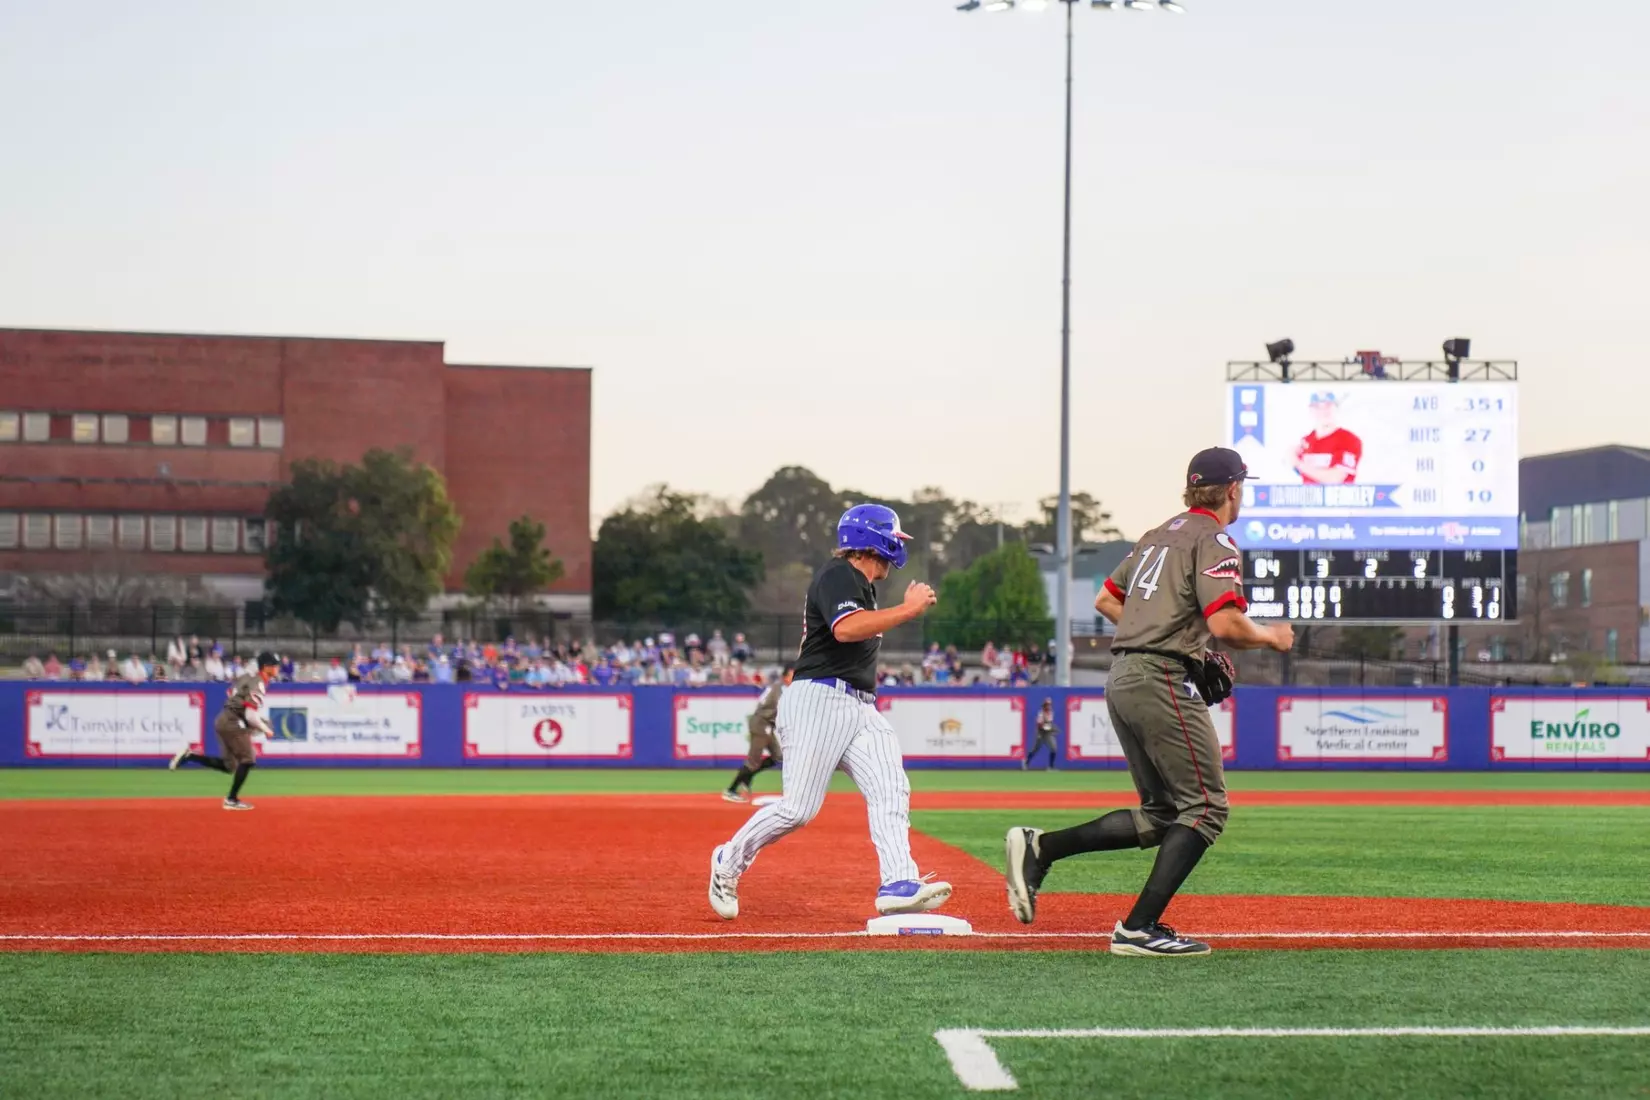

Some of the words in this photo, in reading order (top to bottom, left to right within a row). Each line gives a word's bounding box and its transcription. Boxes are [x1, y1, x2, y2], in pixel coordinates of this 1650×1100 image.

[1410, 427, 1440, 443] HITS
[1464, 429, 1491, 442] 27
[1472, 459, 1485, 473] 0
[1468, 490, 1492, 503] 10
[1267, 523, 1315, 544] Origin
[1317, 523, 1355, 540] Bank
[1309, 550, 1335, 561] BALL
[1353, 550, 1389, 561] STRIKE
[1409, 550, 1431, 561] OUT
[1128, 544, 1169, 600] 14
[1254, 558, 1280, 578] 84
[1316, 558, 1329, 578] 3
[1365, 558, 1378, 578] 2
[1414, 558, 1427, 578] 2
[1287, 586, 1299, 602] 0
[1301, 586, 1312, 602] 0
[1314, 586, 1325, 602] 0
[1330, 586, 1341, 602] 0
[1443, 586, 1454, 602] 0
[1301, 602, 1312, 618] 0
[1335, 602, 1341, 618] 1
[1487, 602, 1499, 618] 0
[141, 716, 184, 735] Creek
[686, 716, 743, 739] Super
[1305, 725, 1361, 737] Northern
[1364, 725, 1420, 737] Louisiana
[1530, 720, 1621, 739] ENVIRO
[1316, 739, 1365, 750] Medical
[1368, 739, 1408, 751] Center
[1546, 742, 1606, 752] RENTALS
